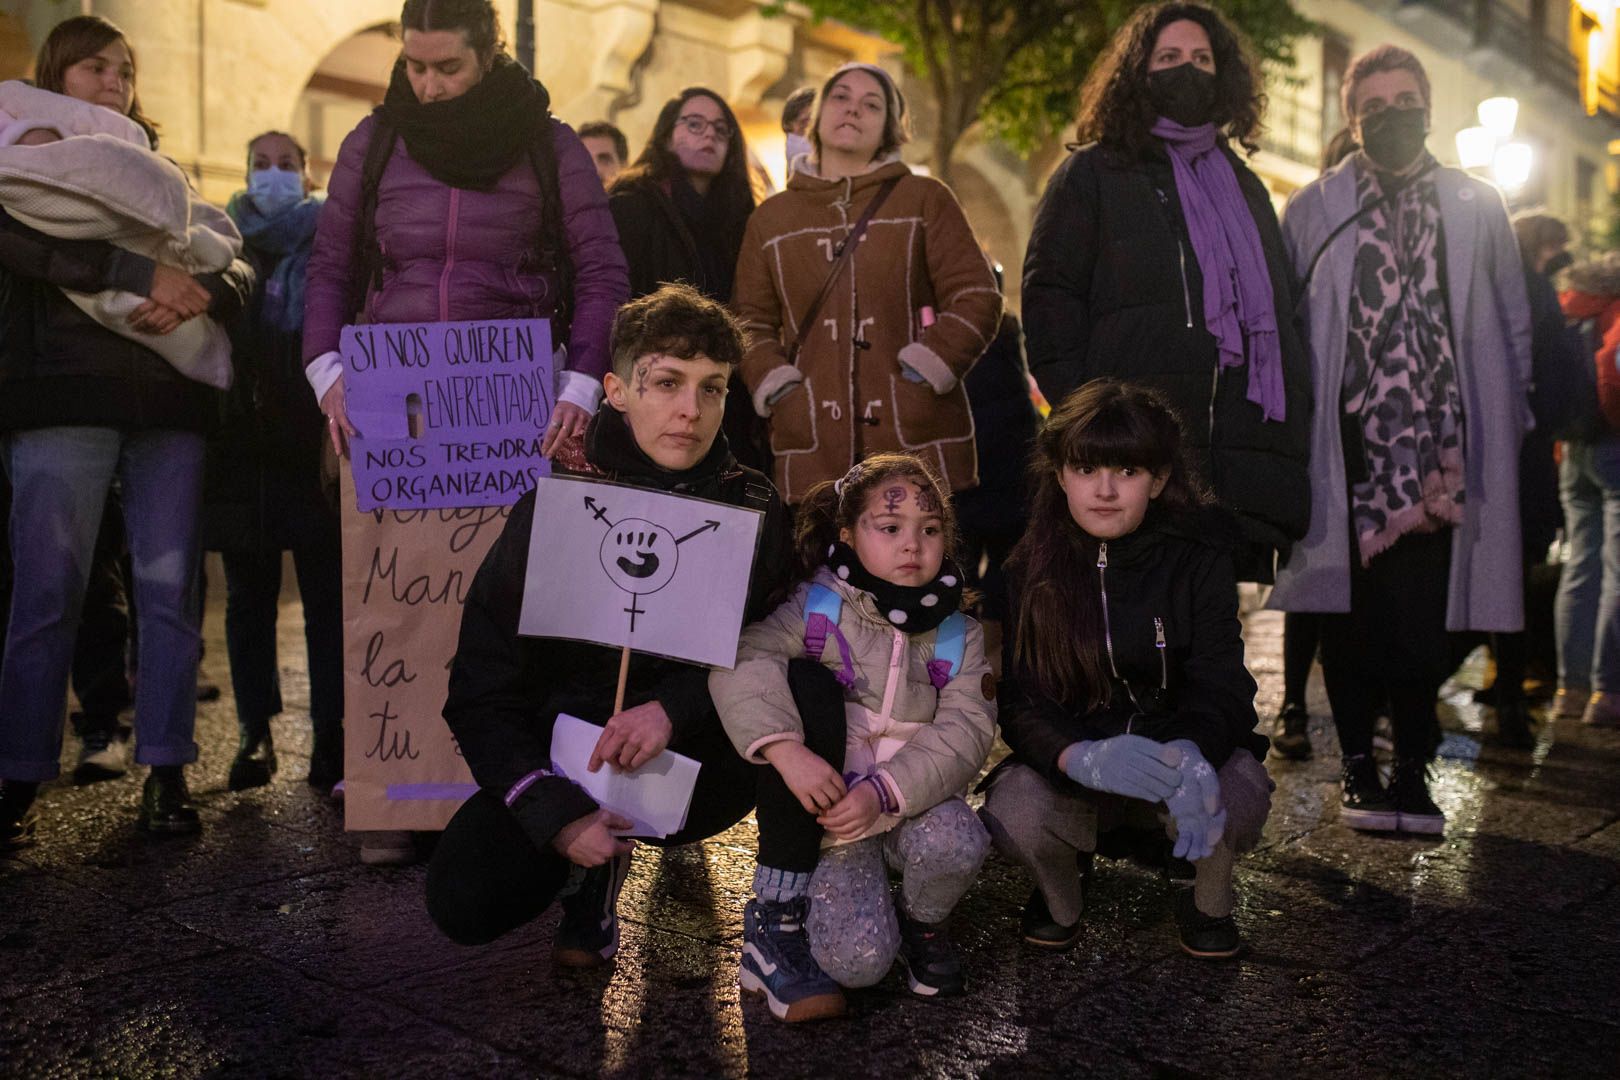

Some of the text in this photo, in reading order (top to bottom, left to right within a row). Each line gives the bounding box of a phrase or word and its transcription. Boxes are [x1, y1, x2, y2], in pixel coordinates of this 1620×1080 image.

[351, 323, 534, 373] SI NOS QUIEREN
[424, 366, 550, 429] ENFRENTADAS
[366, 445, 426, 470] NOS
[362, 546, 465, 605] Man
[361, 631, 417, 687] la
[365, 701, 420, 761] tu
